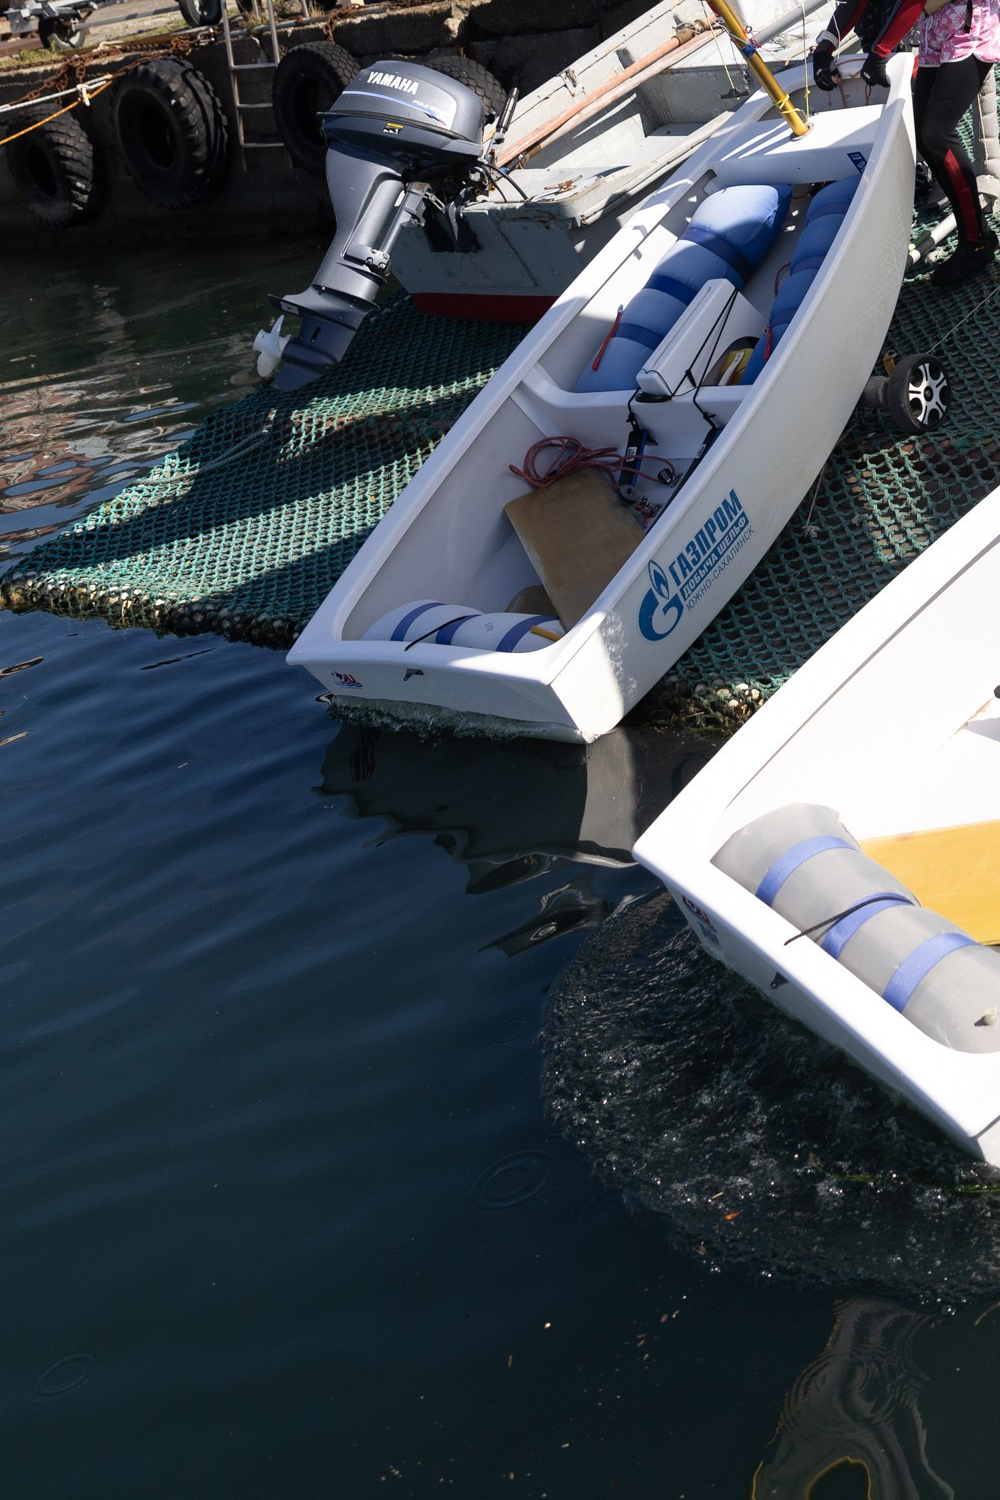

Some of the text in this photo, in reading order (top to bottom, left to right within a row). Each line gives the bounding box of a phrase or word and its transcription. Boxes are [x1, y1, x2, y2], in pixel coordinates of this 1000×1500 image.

[366, 71, 420, 96] YAMAHA
[668, 488, 743, 587] ГАЗПРОМ
[683, 516, 747, 598] ДОБЫЧА ШЕЛЬФ
[686, 527, 755, 612] ЮЖНО-САХАЛИНСК
